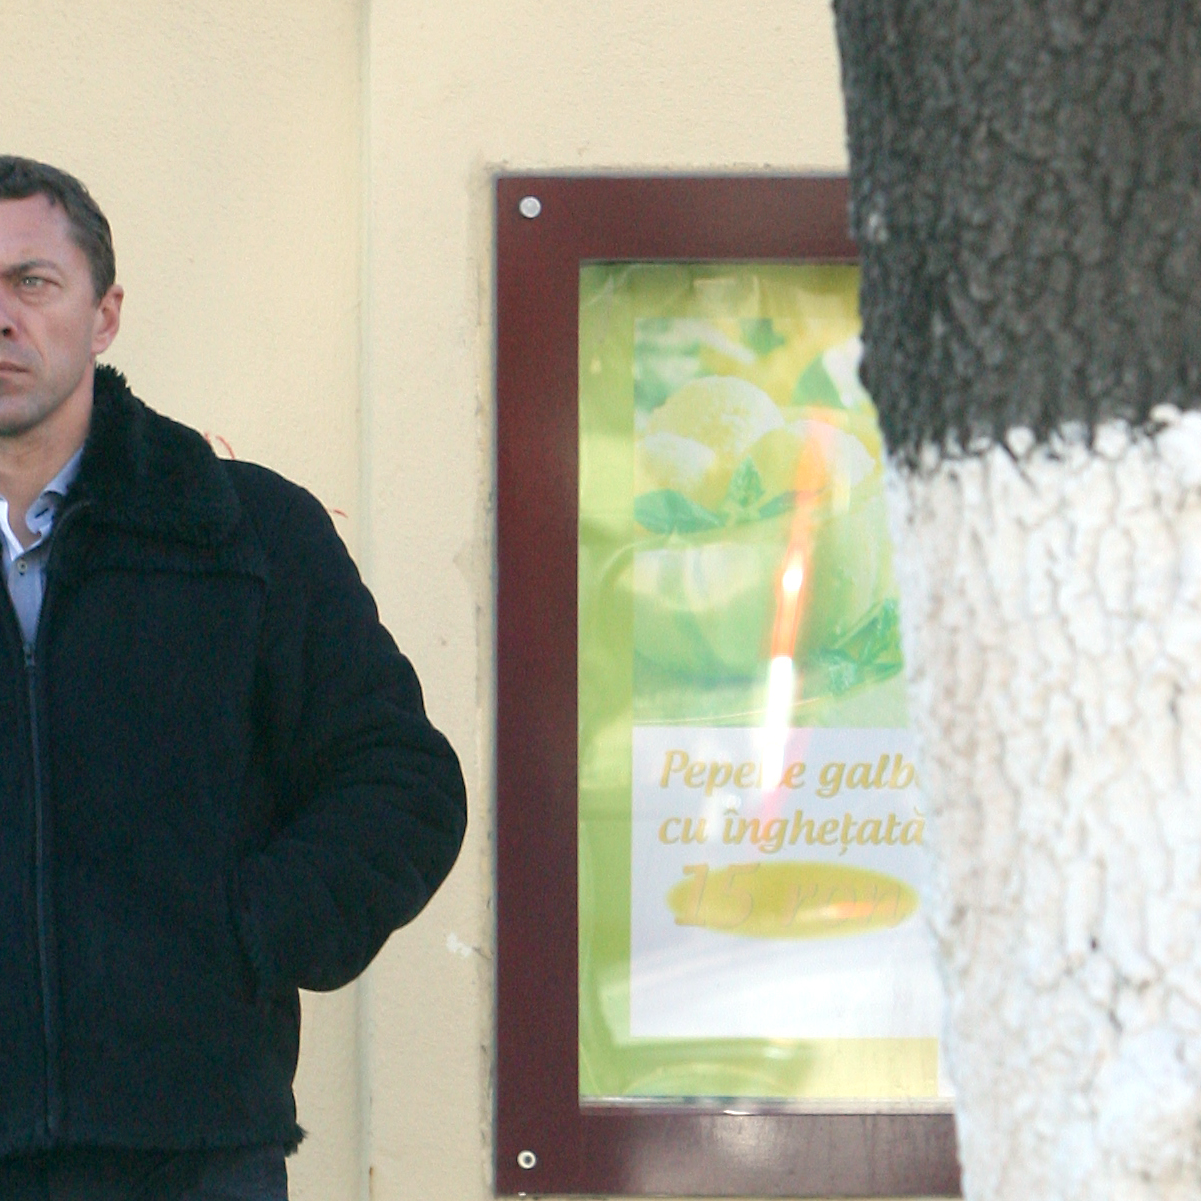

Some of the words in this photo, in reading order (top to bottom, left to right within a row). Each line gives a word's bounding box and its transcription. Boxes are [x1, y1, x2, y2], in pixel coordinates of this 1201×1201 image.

[659, 748, 807, 797] Pepee
[815, 752, 923, 798] galb
[658, 816, 708, 845] cu
[674, 863, 761, 928] 15
